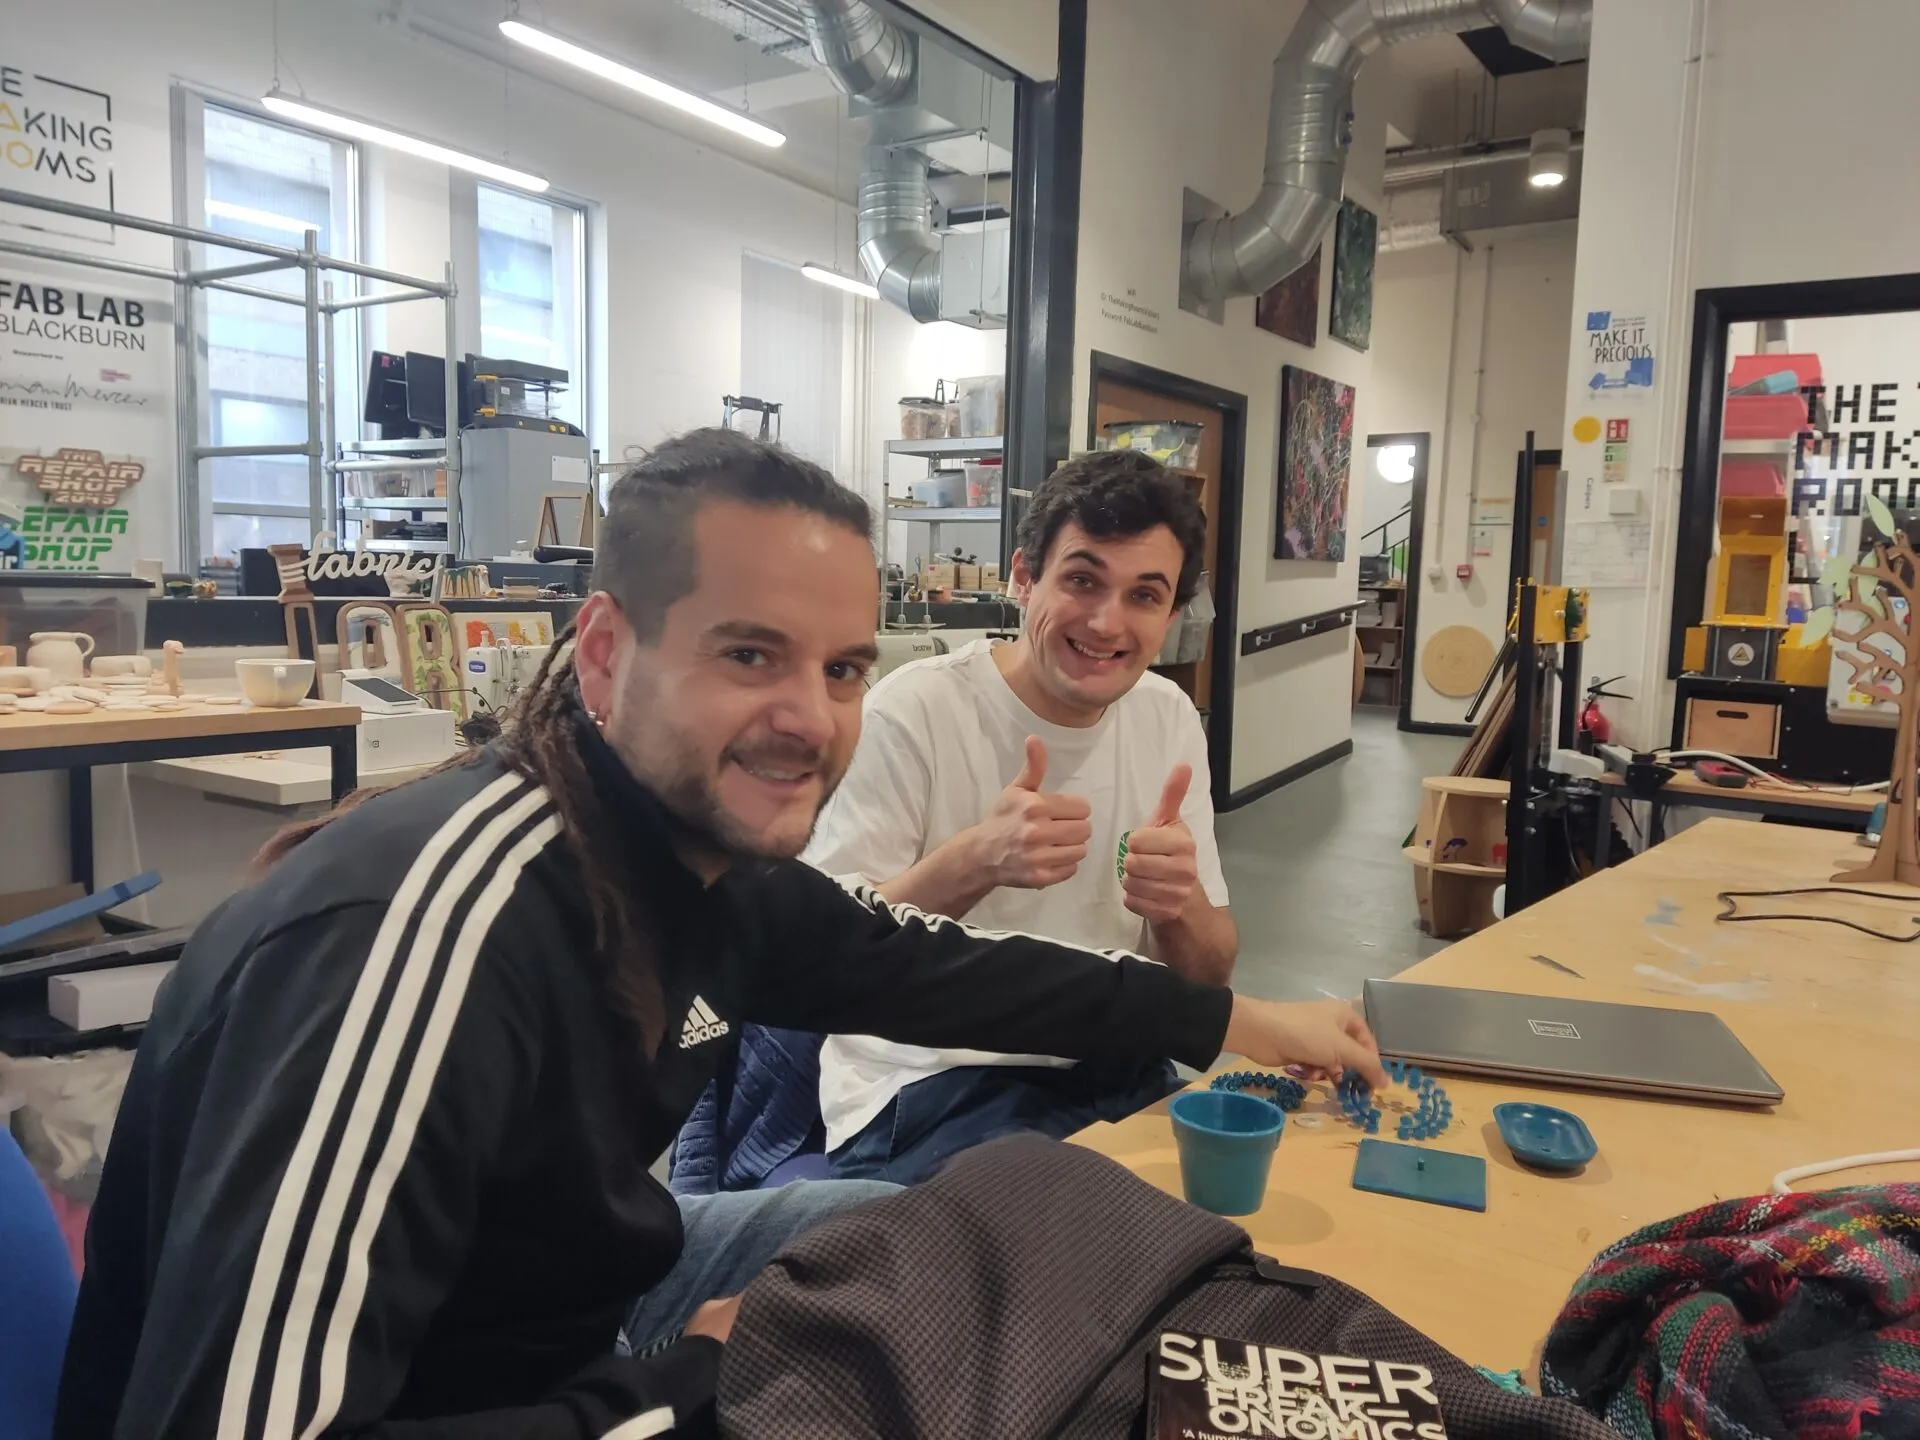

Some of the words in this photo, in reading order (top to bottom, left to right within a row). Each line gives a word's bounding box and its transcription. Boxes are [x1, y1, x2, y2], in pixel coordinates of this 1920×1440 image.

[0, 141, 96, 183] OMS
[0, 280, 65, 316] FAB
[76, 292, 145, 328] LAB
[0, 314, 145, 351] BLACKBURN
[1590, 329, 1628, 347] MAKE
[1633, 328, 1645, 344] IT
[1595, 344, 1652, 363] PRECIOUS
[1800, 383, 1898, 424] THE
[19, 458, 142, 480] REPAIR
[38, 475, 128, 493] SHOP
[12, 506, 129, 534] EPAIR
[24, 536, 113, 562] SHOP
[679, 1021, 730, 1049] adidas
[1159, 1333, 1439, 1405] SUPER
